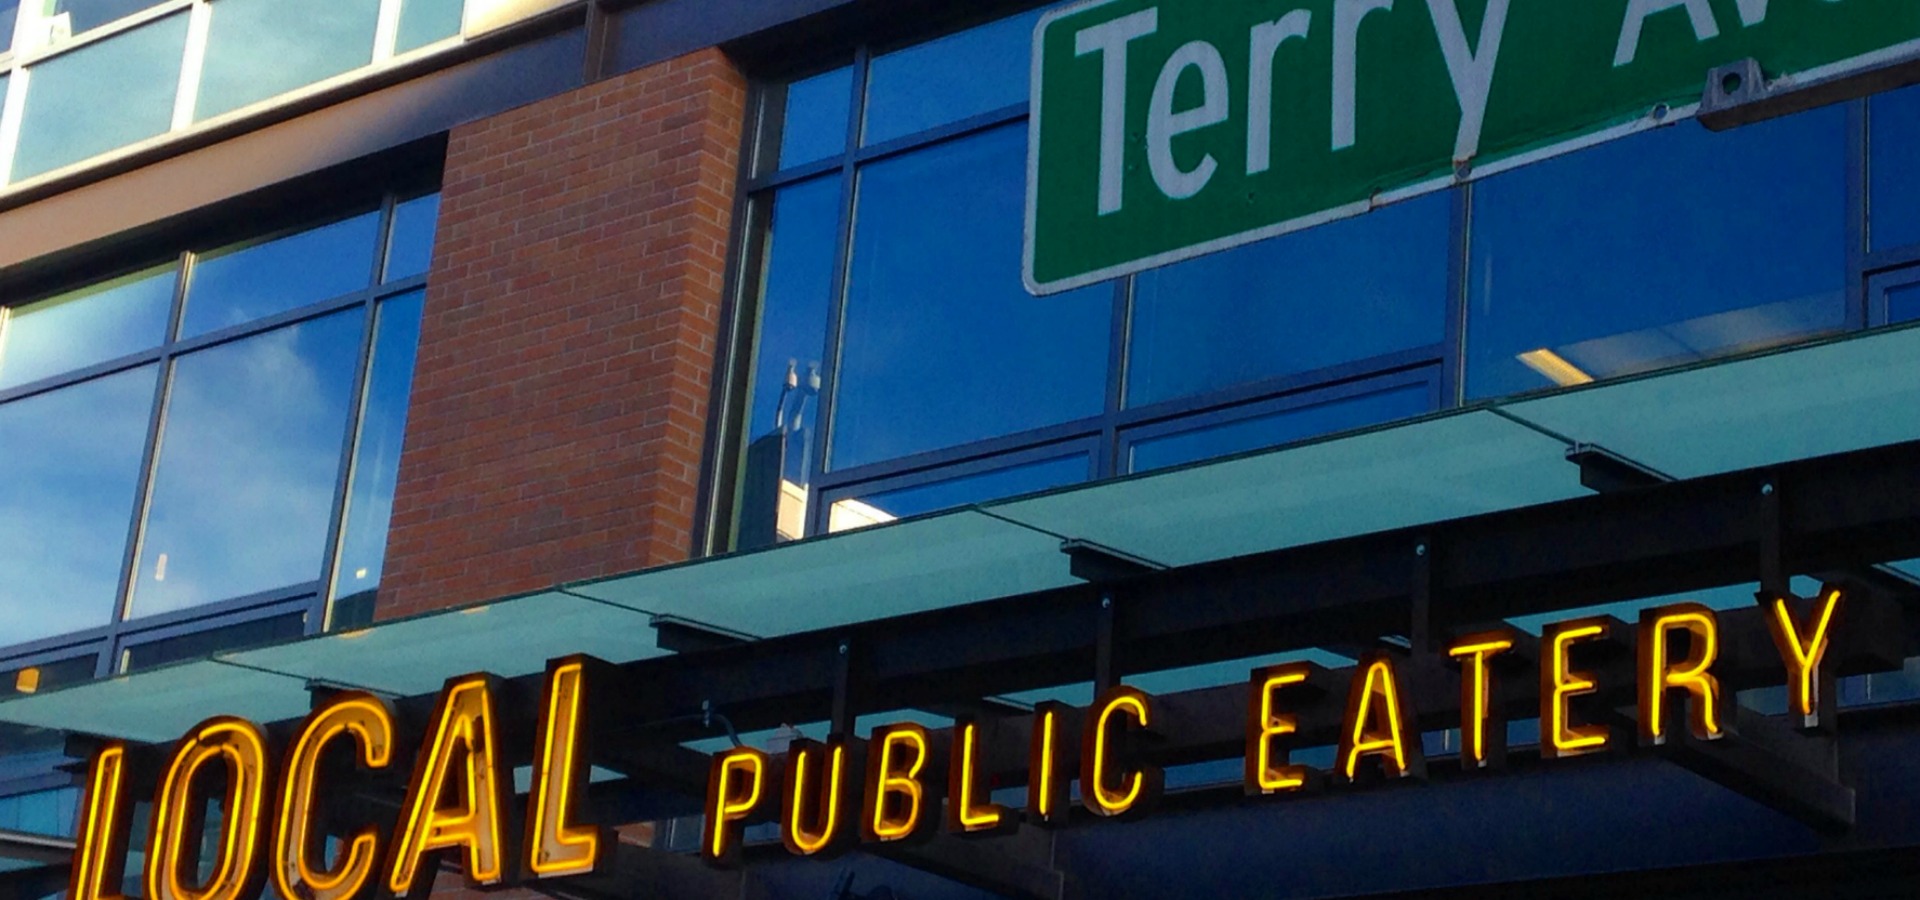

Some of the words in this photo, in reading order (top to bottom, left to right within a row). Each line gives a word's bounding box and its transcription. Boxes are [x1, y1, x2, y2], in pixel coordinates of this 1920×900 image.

[1074, 0, 1510, 216] Terry
[74, 661, 597, 900] LOCAL
[711, 694, 1149, 859] PUBLIC
[1257, 588, 1842, 793] EATERY
